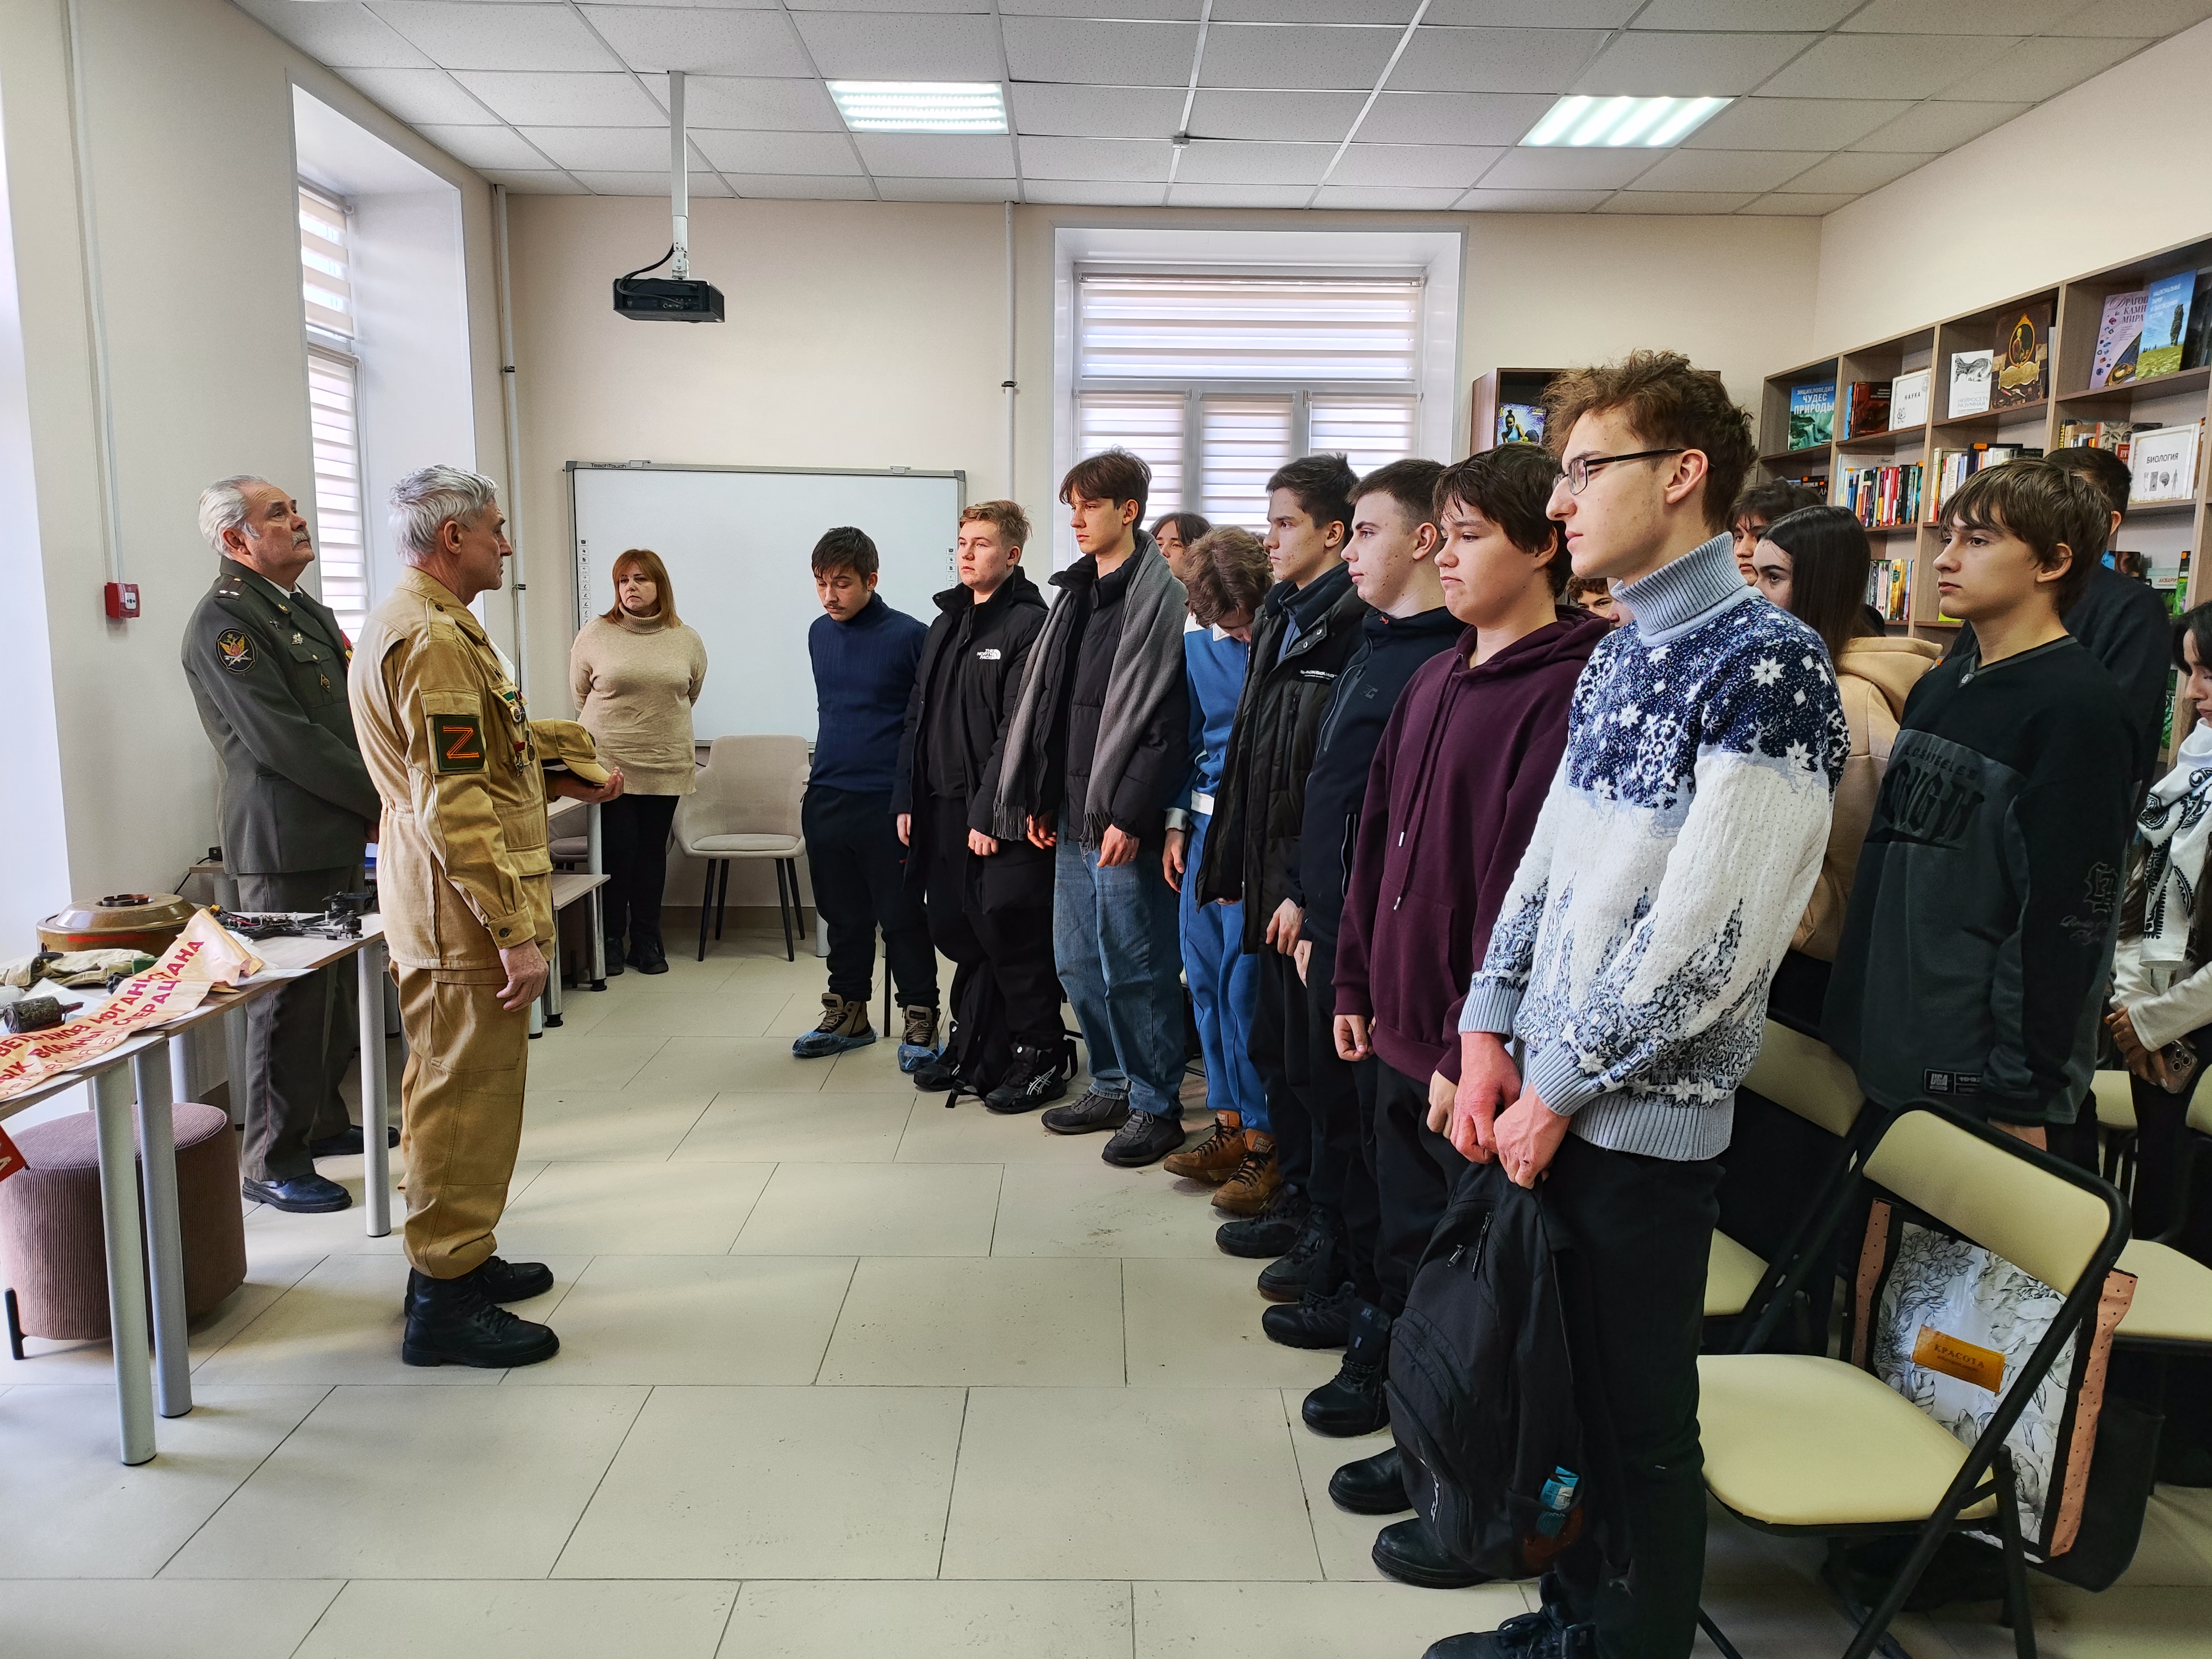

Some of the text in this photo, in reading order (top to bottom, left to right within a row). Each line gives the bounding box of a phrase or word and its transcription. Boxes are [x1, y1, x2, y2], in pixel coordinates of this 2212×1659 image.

[2122, 314, 2144, 324] МИРА
[1797, 385, 1834, 395] ЭНЦИКЛОПЕДИЯ
[1803, 393, 1827, 404] ЧУДЕС
[1904, 392, 1921, 400] НАУКА
[1794, 402, 1835, 415] ПРИРОДЫ
[2146, 453, 2178, 464] БИОЛОГИЯ
[443, 726, 479, 759] Z
[28, 1030, 106, 1058] ВОЕННЫ
[1934, 1344, 1984, 1368] КРАСОТА
